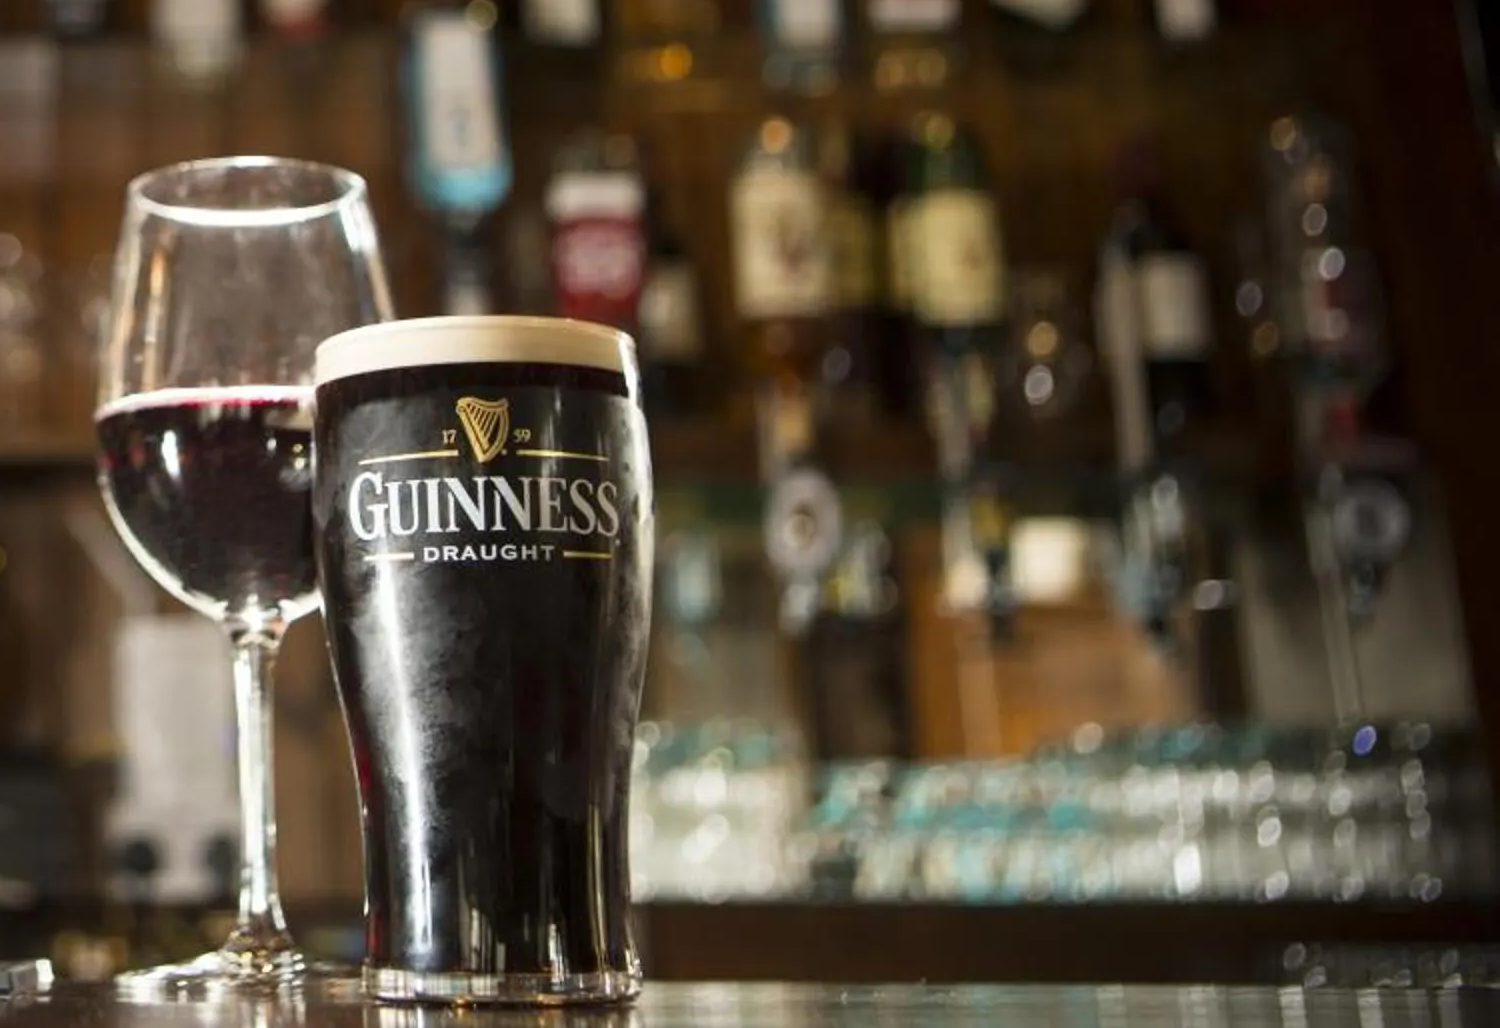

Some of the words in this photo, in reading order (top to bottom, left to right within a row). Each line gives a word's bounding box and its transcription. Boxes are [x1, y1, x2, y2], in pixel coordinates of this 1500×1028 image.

[442, 429, 456, 444] 17
[513, 428, 531, 443] 59
[348, 471, 619, 541] GUINNESS
[423, 544, 555, 562] DRAUGHT
